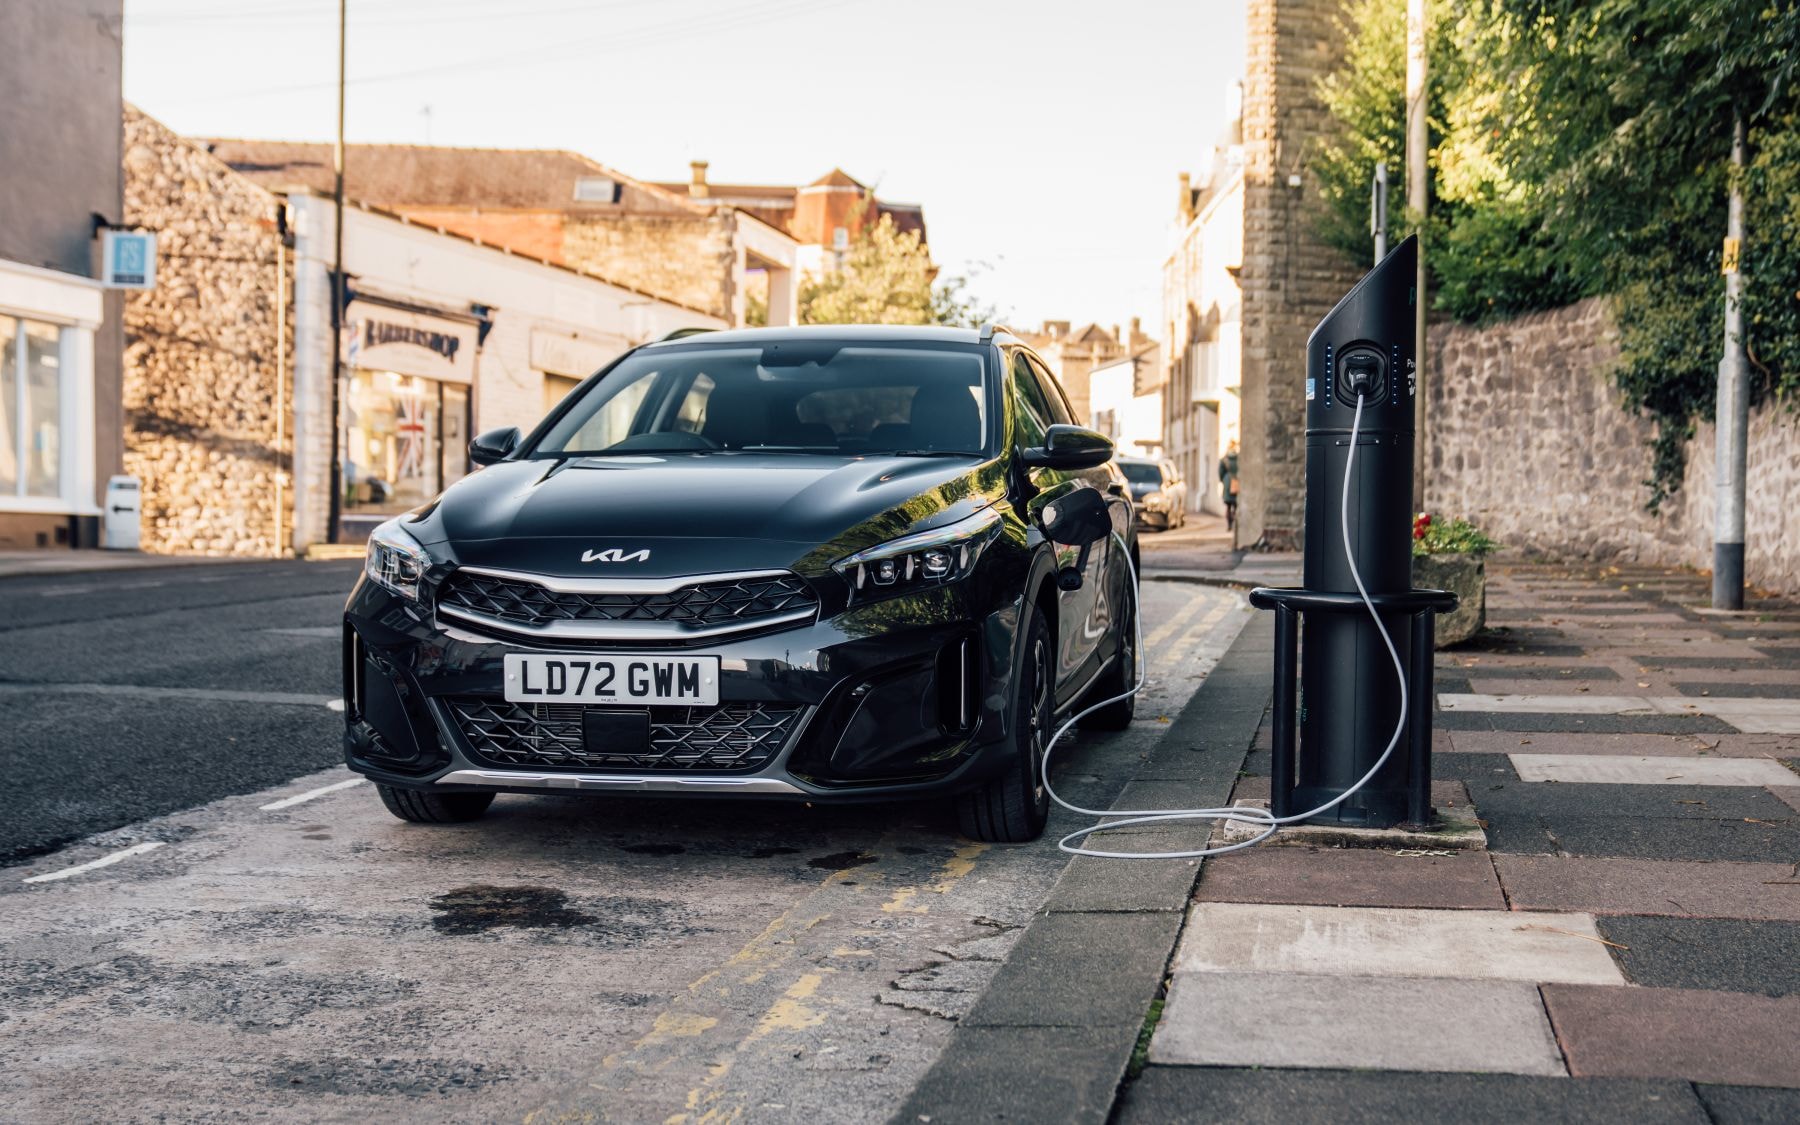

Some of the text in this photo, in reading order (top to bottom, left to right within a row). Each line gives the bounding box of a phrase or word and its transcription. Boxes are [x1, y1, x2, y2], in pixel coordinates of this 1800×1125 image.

[363, 318, 460, 364] BARBERSHOP
[581, 549, 651, 562] KIA
[521, 660, 700, 698] LD72 GWM
